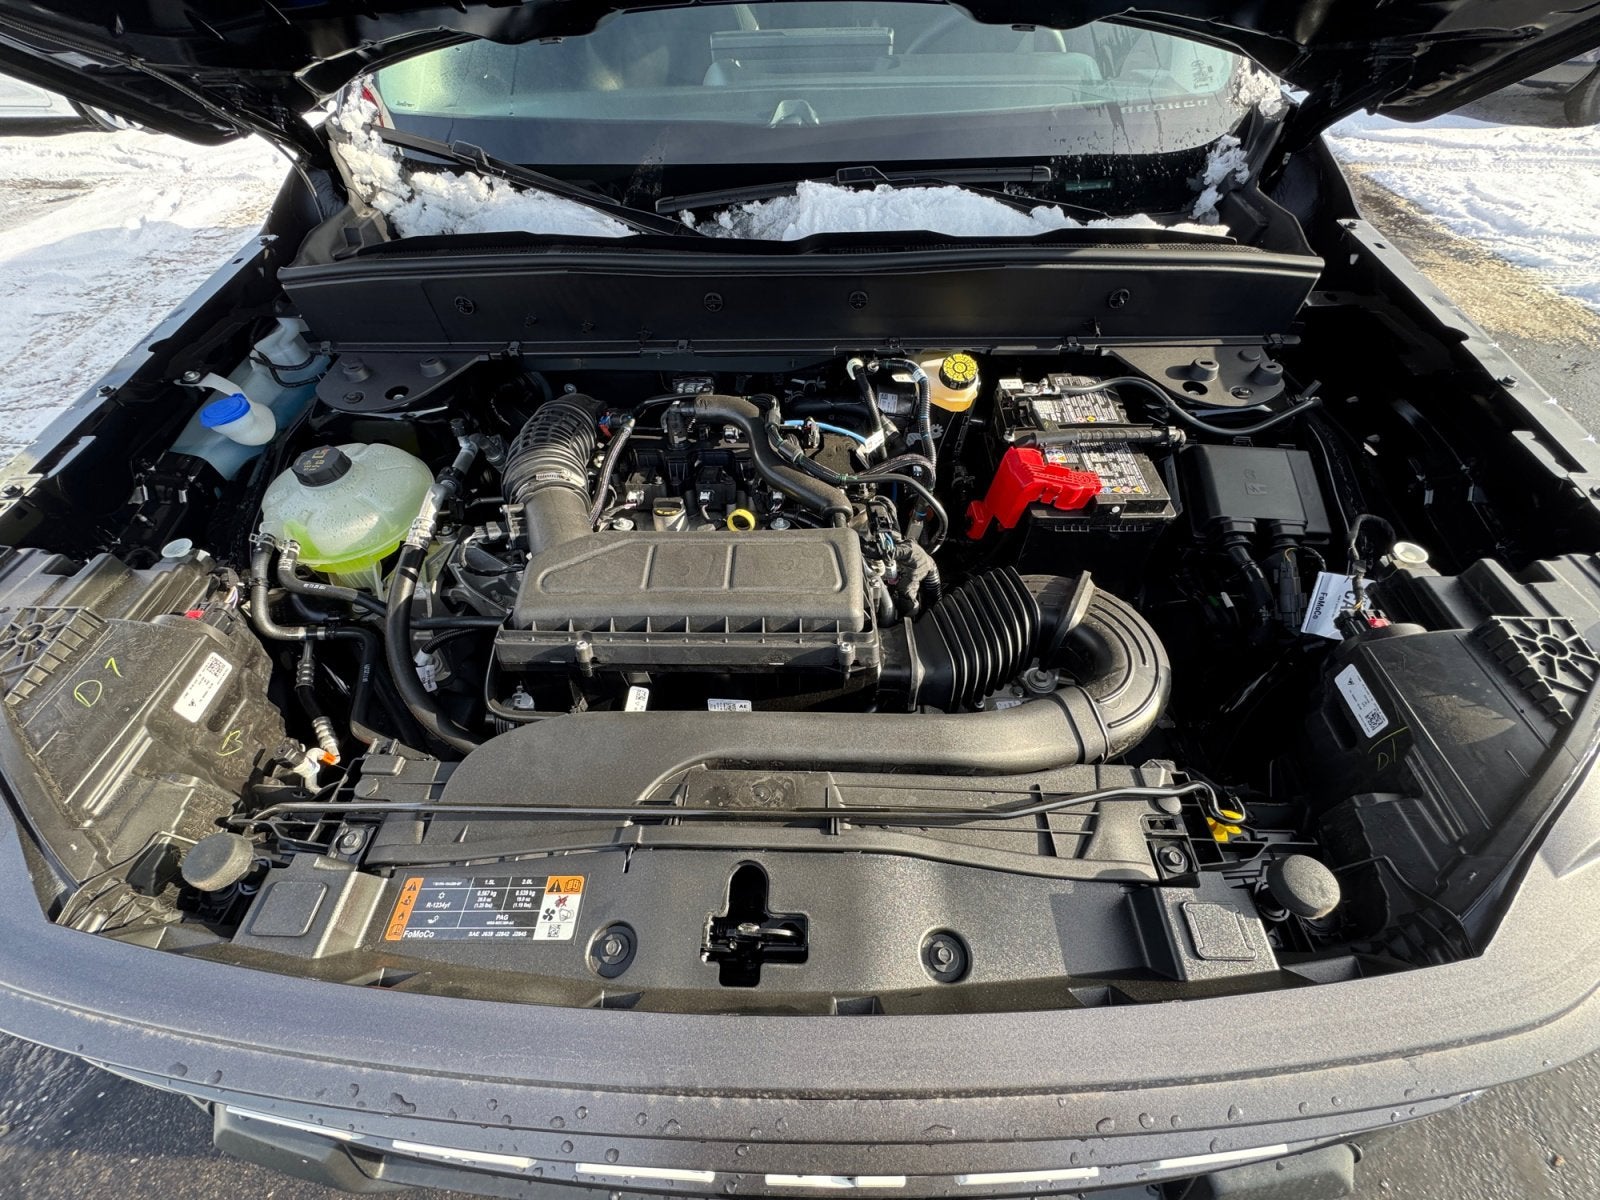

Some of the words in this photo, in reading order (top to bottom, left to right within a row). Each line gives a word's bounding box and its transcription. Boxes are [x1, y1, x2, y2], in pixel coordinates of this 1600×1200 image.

[1312, 591, 1328, 620] FoMoCo
[425, 901, 451, 909] R-1234yf
[403, 930, 435, 938] FoMoCo
